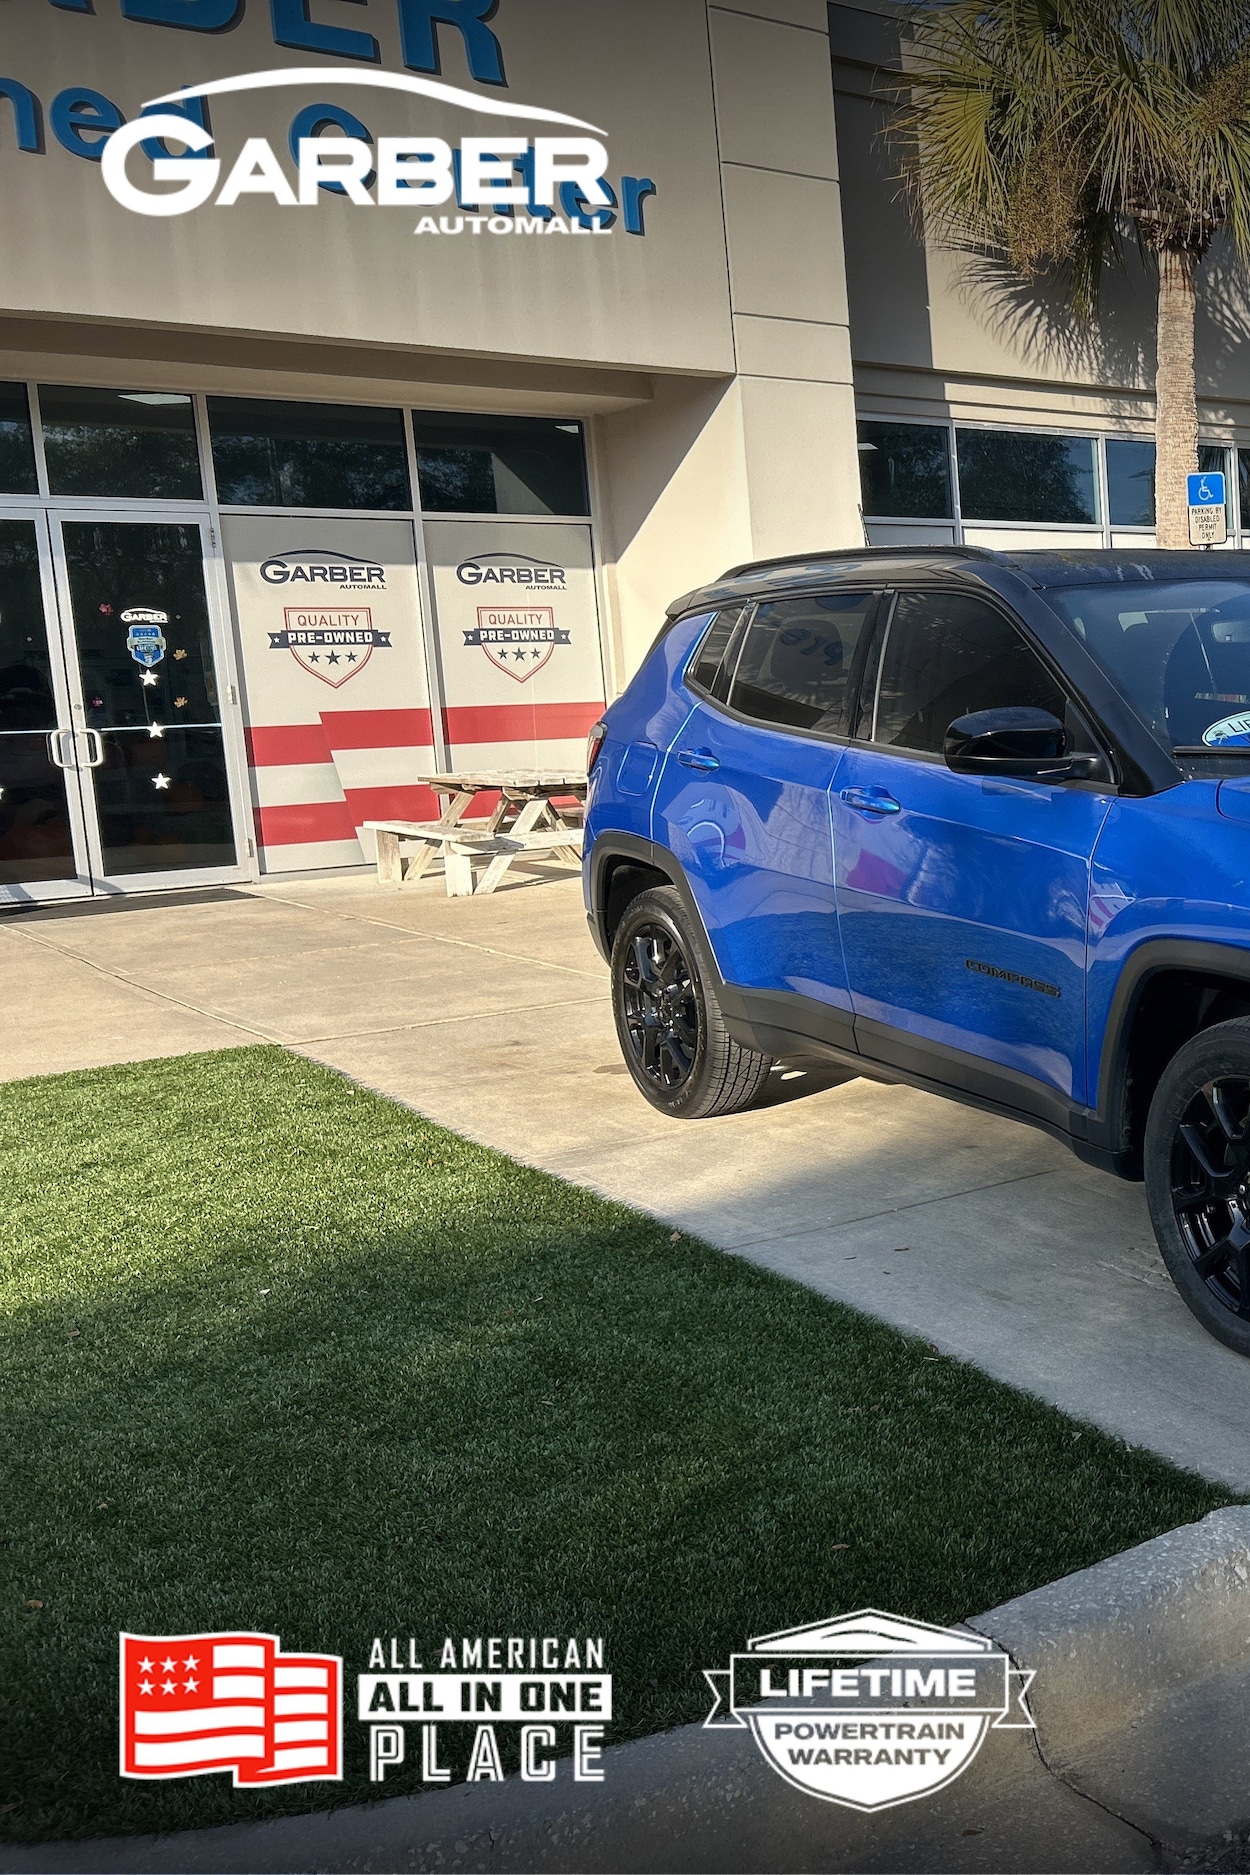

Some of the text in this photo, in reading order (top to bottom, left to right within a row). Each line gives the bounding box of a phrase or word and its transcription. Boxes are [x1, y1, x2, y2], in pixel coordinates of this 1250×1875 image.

[1191, 506, 1222, 515] PARKING BY
[1194, 515, 1220, 524] DISABLED
[1198, 523, 1217, 531] PERMIT
[1201, 531, 1215, 539] ONLY
[259, 559, 386, 585] GARBER
[456, 562, 567, 586] GARBER
[297, 614, 360, 627] QUALITY
[488, 613, 543, 625] QUALITY
[287, 631, 374, 644] PRE-OWNED
[479, 629, 555, 641] PRE-OWNED
[965, 959, 1061, 998] COMPASS
